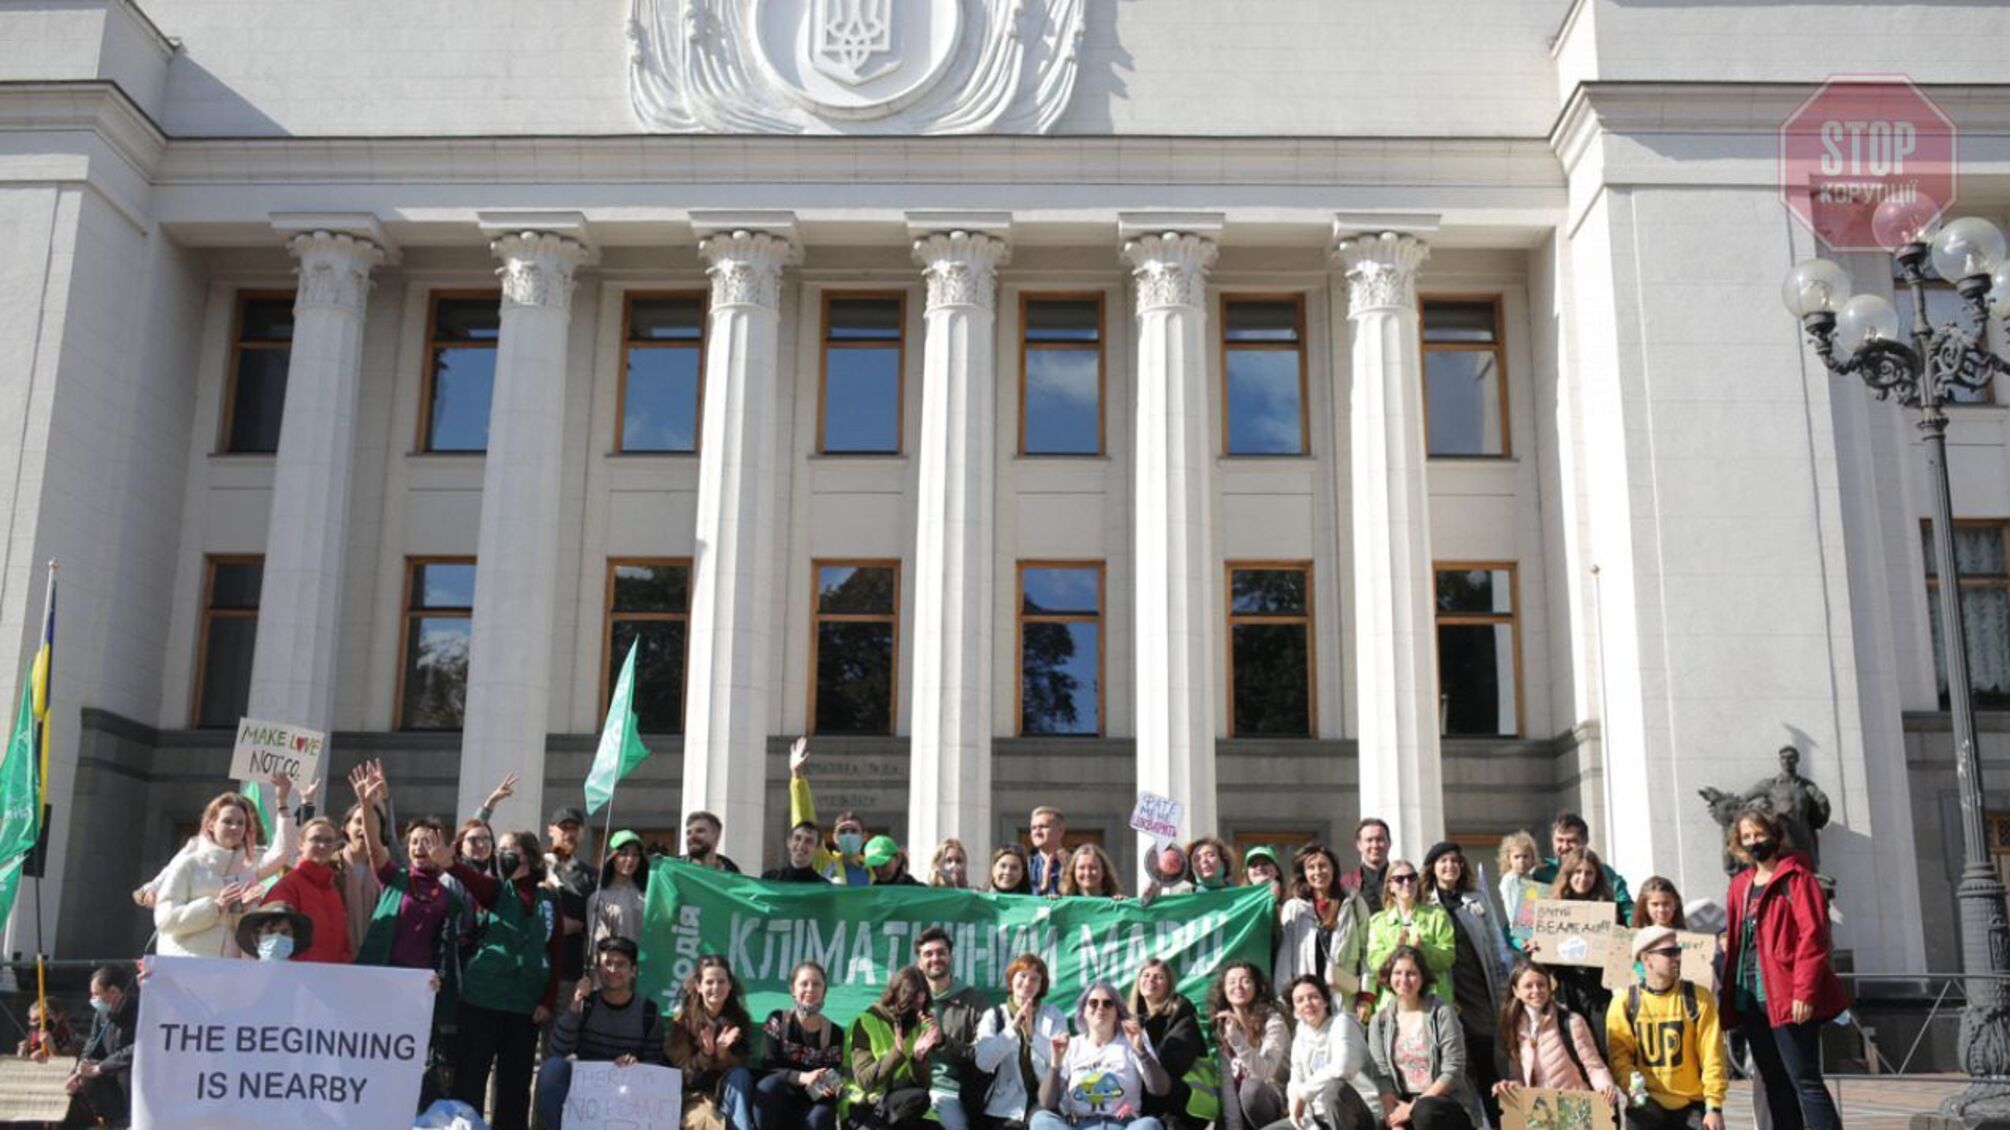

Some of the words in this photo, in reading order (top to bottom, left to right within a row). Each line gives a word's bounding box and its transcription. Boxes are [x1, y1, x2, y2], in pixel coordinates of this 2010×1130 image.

[240, 725, 287, 747] MAKE
[249, 750, 285, 776] NOT
[1079, 912, 1229, 989] МАРШ
[159, 1023, 226, 1052] THE
[236, 1026, 417, 1061] BEGINNING
[1639, 1021, 1683, 1068] UP
[196, 1071, 228, 1100] IS
[239, 1072, 368, 1104] NEARBY
[567, 1096, 600, 1121] NO
